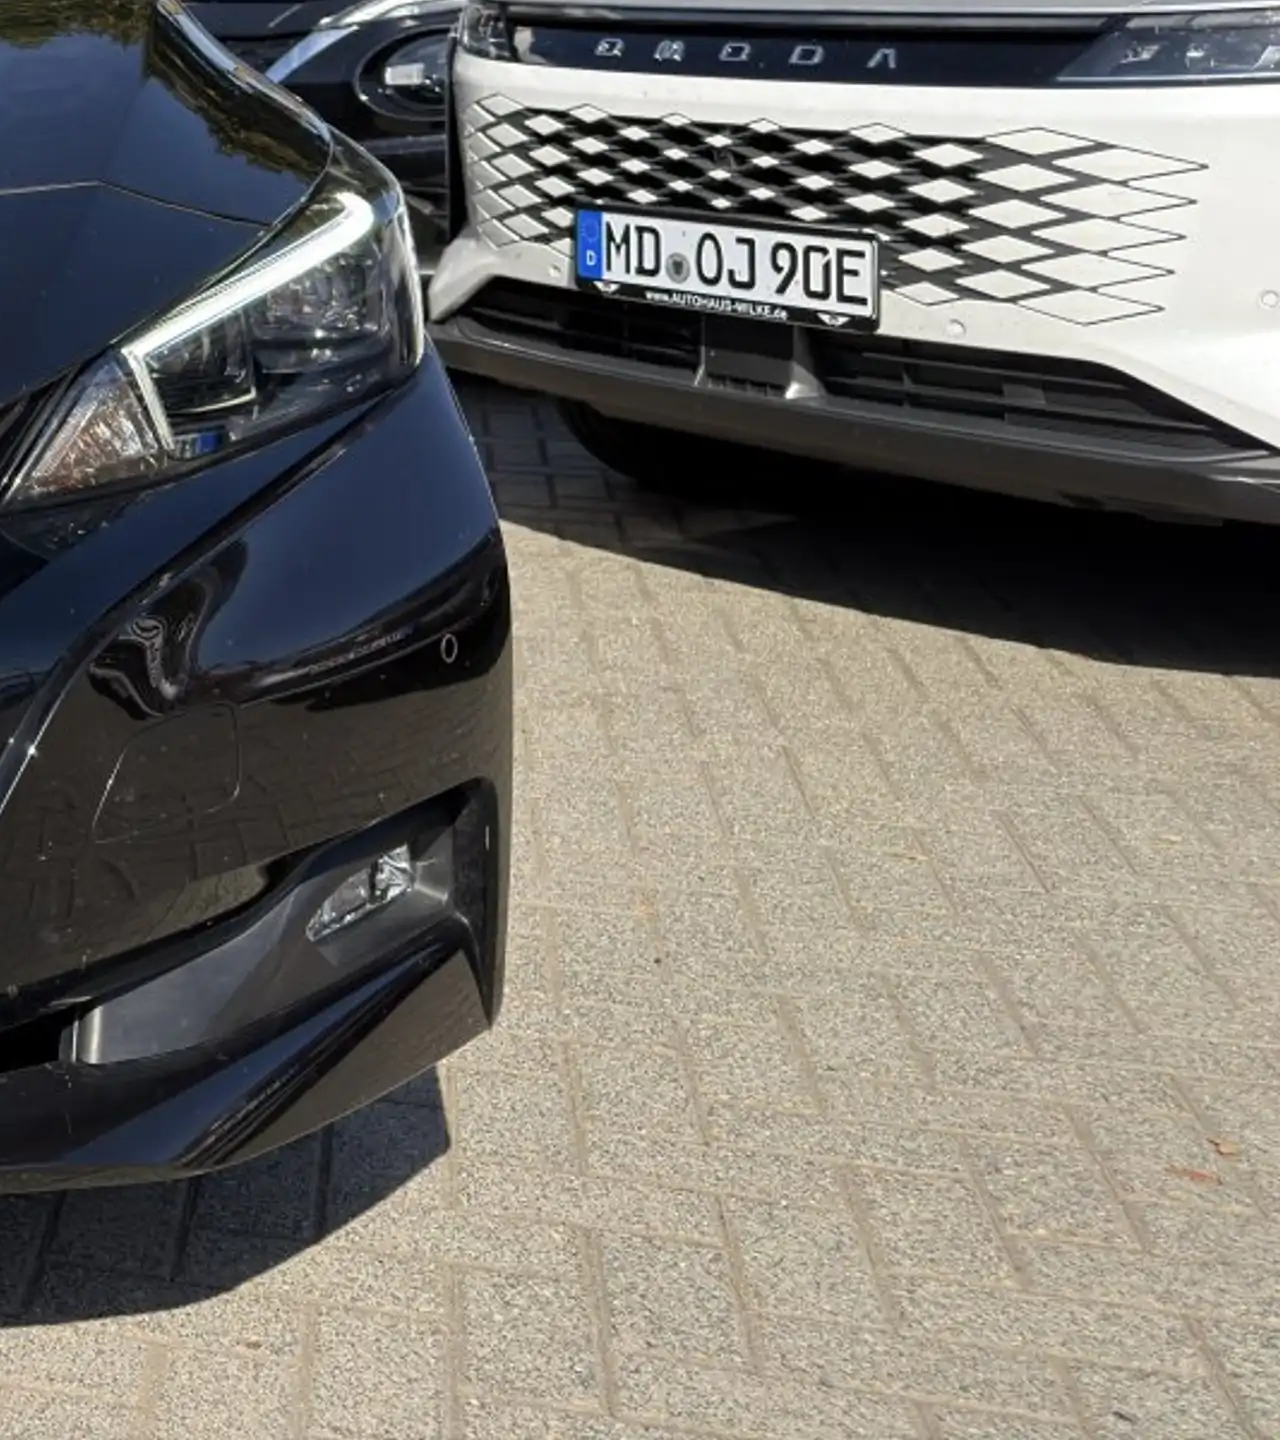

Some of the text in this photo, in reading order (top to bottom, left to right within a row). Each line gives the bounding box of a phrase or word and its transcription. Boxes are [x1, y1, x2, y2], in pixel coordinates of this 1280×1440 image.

[605, 220, 868, 306] MD OJ 90E
